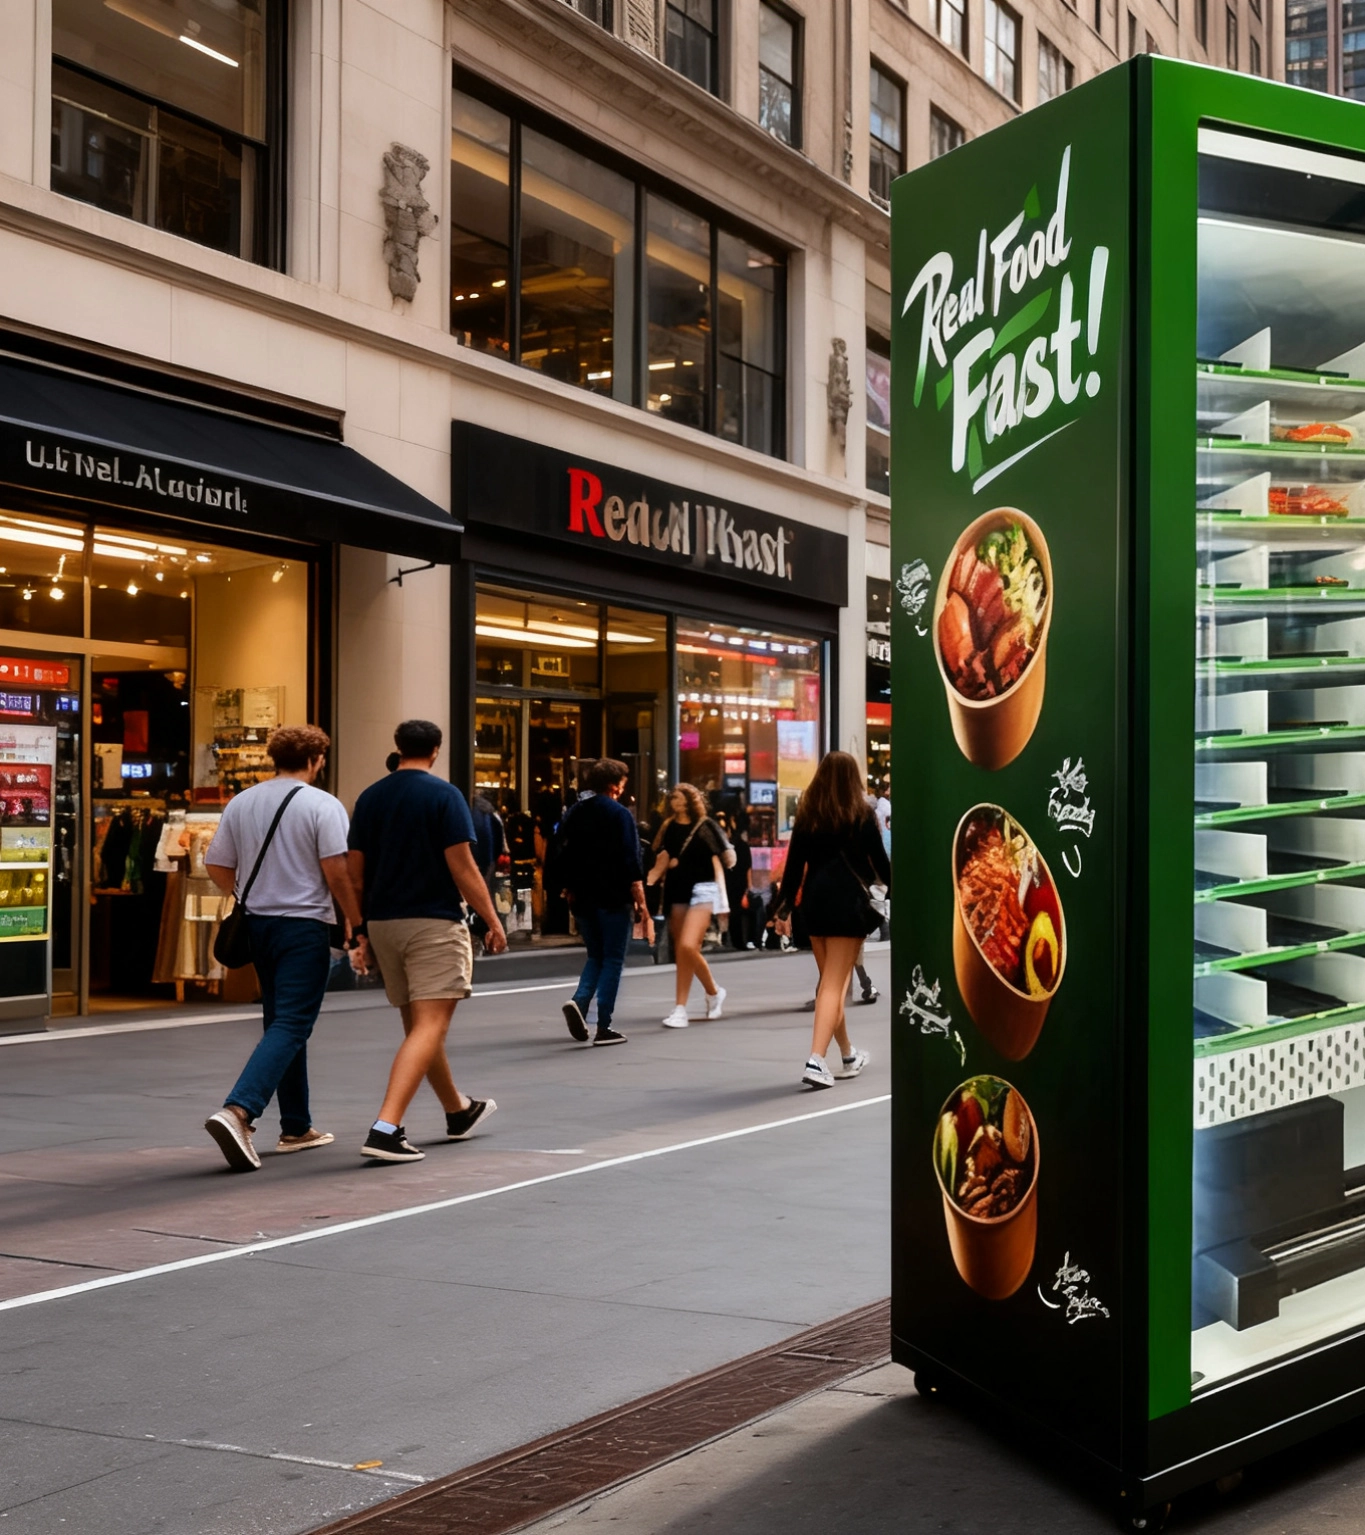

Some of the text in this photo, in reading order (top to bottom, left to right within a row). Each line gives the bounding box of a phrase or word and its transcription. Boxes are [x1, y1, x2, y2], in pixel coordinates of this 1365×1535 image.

[901, 144, 1073, 404] Real Food
[951, 246, 1110, 473] Fast!
